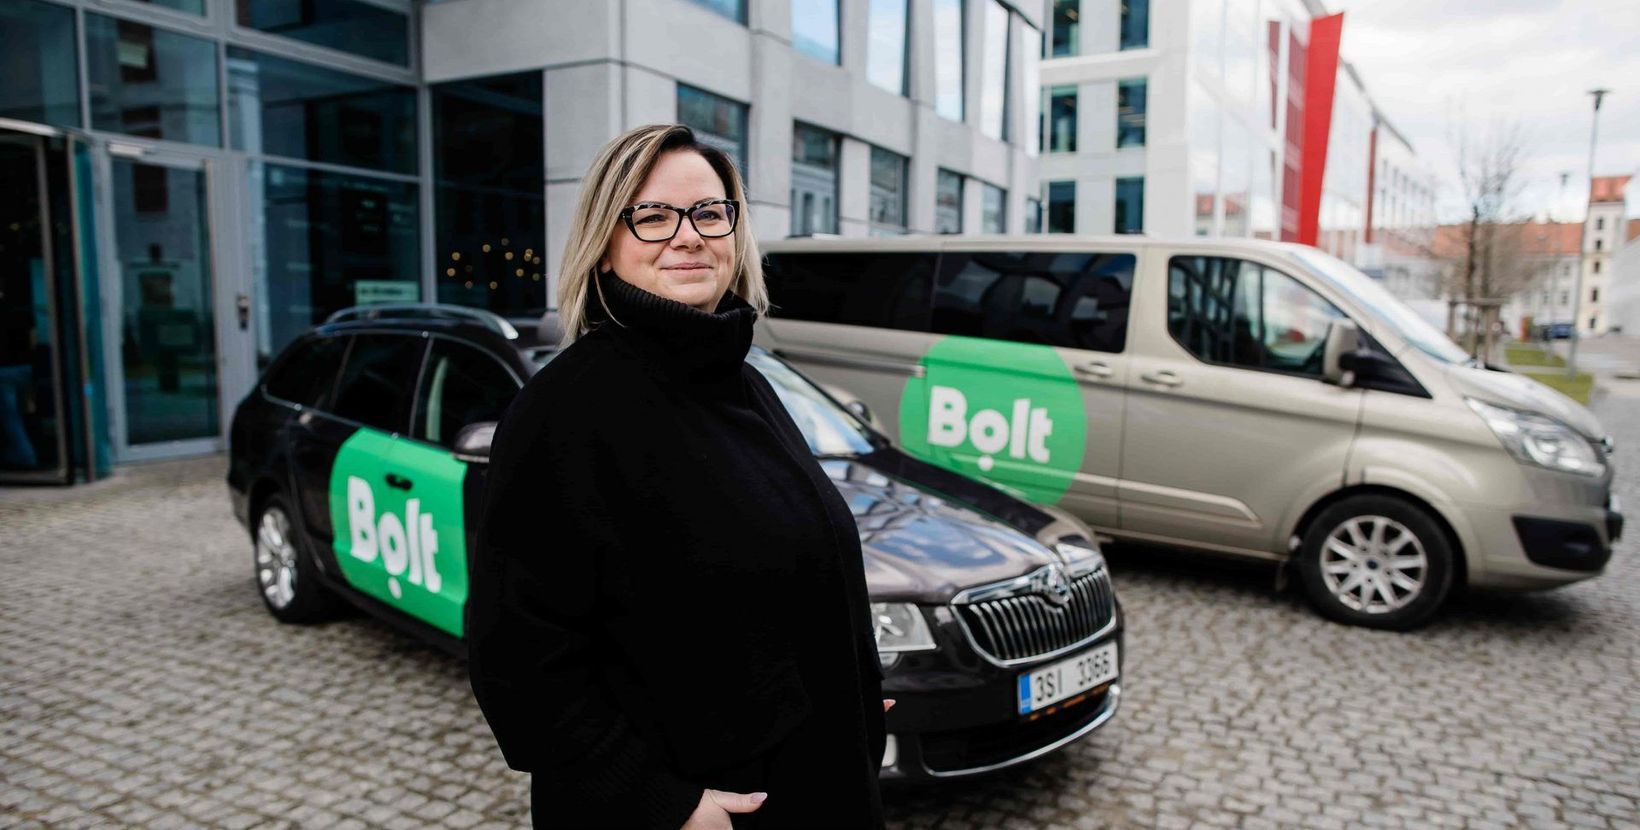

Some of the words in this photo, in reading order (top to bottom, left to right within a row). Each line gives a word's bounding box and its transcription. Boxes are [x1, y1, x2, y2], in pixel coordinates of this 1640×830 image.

[928, 385, 1053, 471] Bolt
[347, 475, 442, 599] Bolt
[1035, 667, 1063, 702] 3SI
